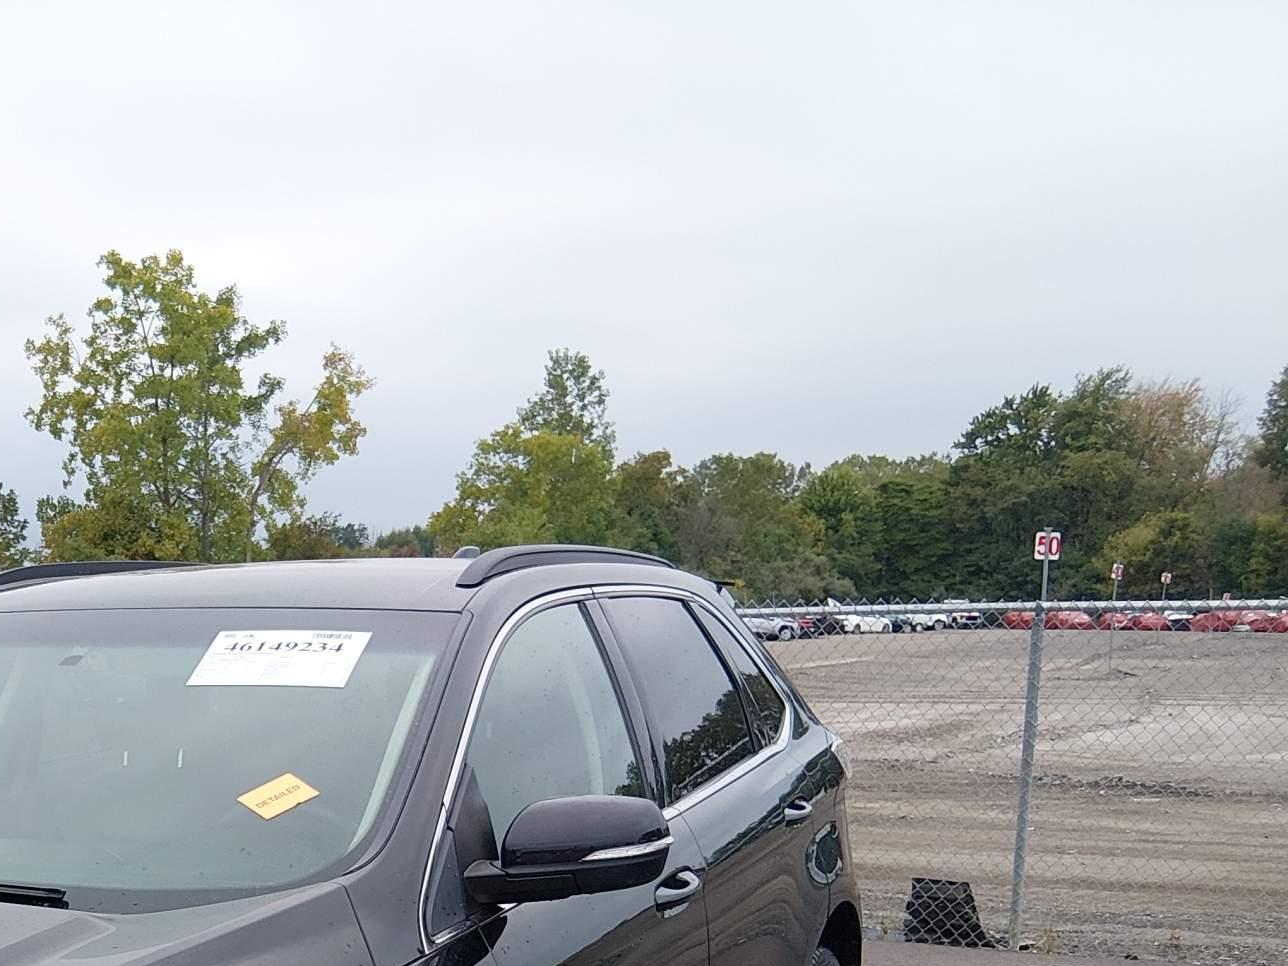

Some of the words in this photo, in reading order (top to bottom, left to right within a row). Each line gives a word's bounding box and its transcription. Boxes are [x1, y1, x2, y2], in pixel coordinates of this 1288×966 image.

[1037, 535, 1060, 556] 50
[224, 641, 344, 653] 46149234
[255, 784, 301, 809] DETAILED
